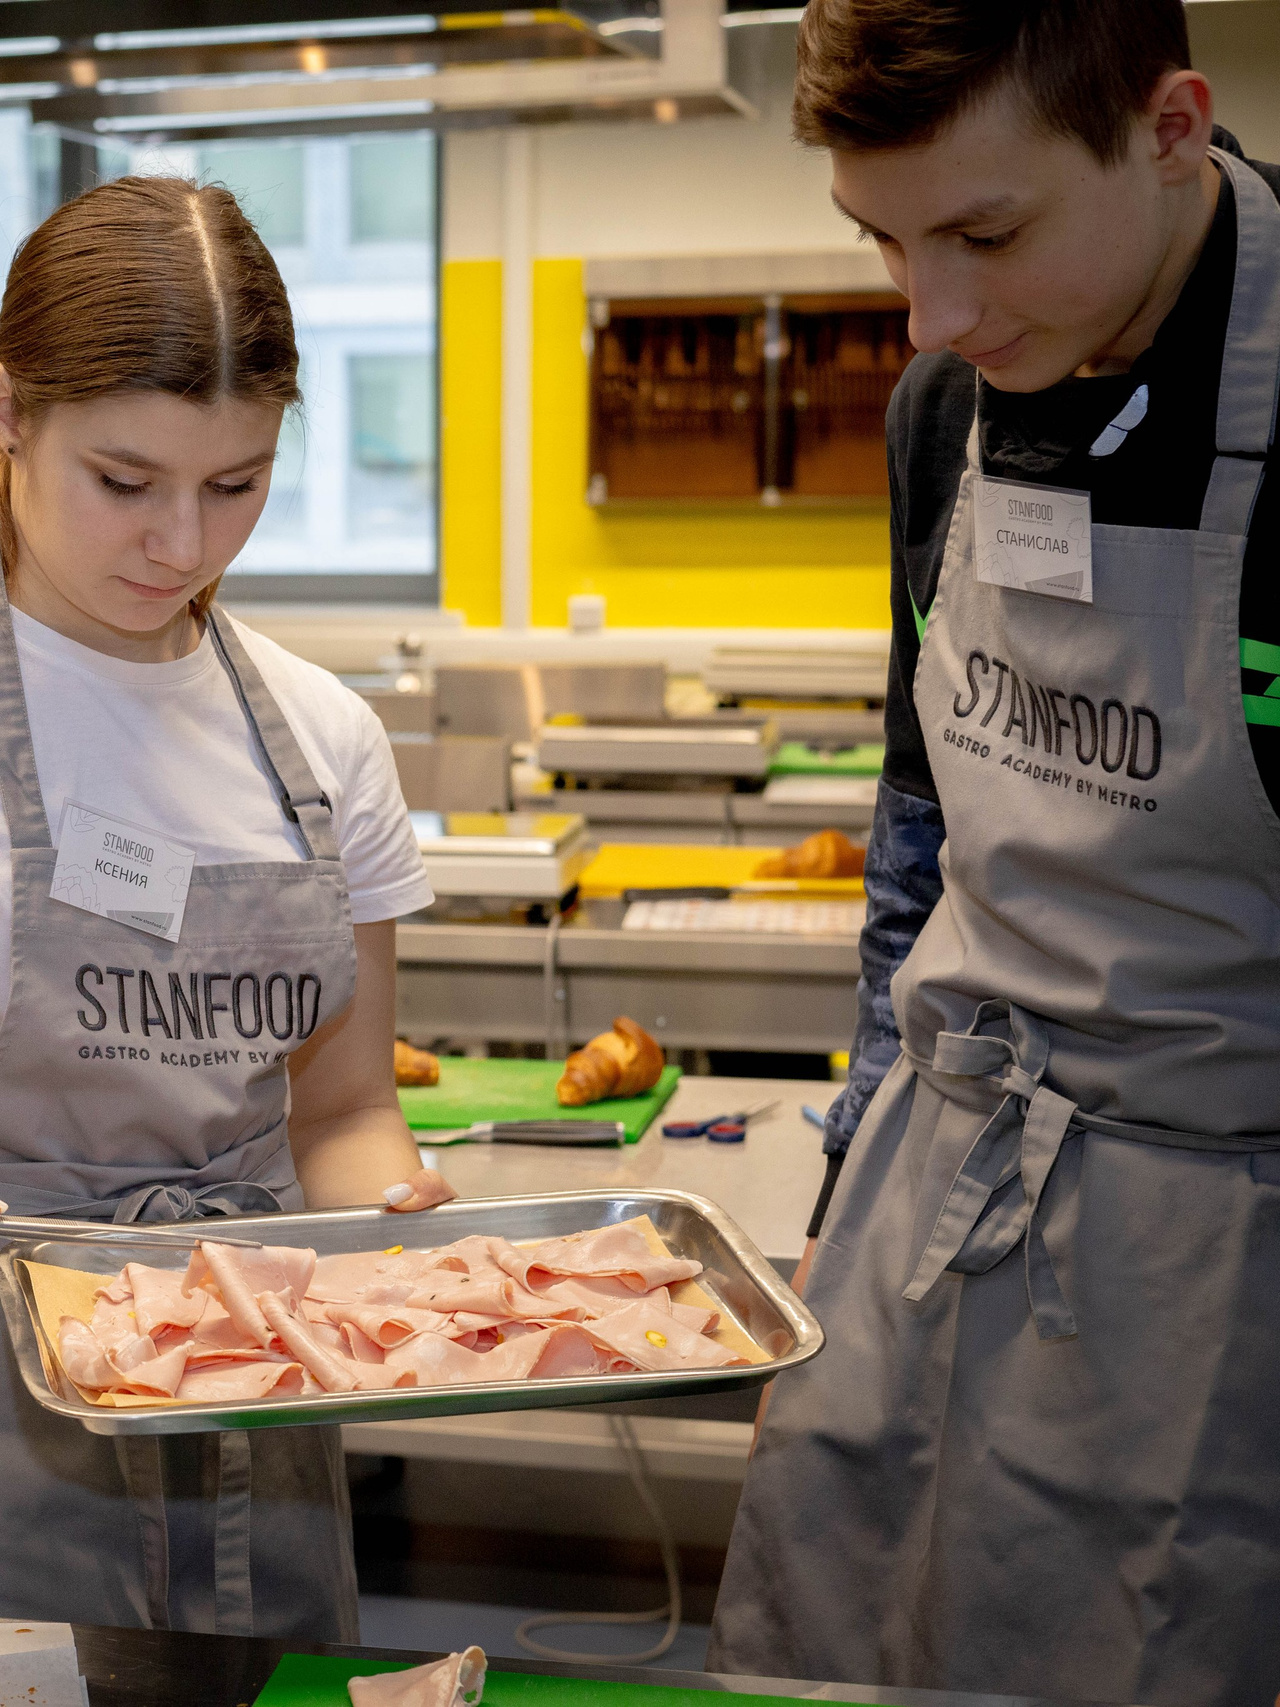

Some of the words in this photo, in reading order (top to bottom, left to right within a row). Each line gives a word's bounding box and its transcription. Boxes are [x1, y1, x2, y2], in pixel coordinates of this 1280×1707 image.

[1007, 499, 1053, 521] STANFOOD
[996, 529, 1069, 554] СТАНИСЛАВ
[953, 650, 1162, 781] STANFOOD
[943, 728, 991, 759] GASTRO
[1000, 754, 1072, 788] ACADEMY
[1076, 779, 1093, 797] BY
[1098, 785, 1158, 813] METRO
[103, 832, 154, 863] STANFOOD
[94, 858, 148, 889] КСЕНИЯ
[75, 963, 322, 1041] STANFOOD
[78, 1045, 150, 1061] GASTRO
[160, 1050, 240, 1068] ACADEMY
[248, 1051, 269, 1065] BY
